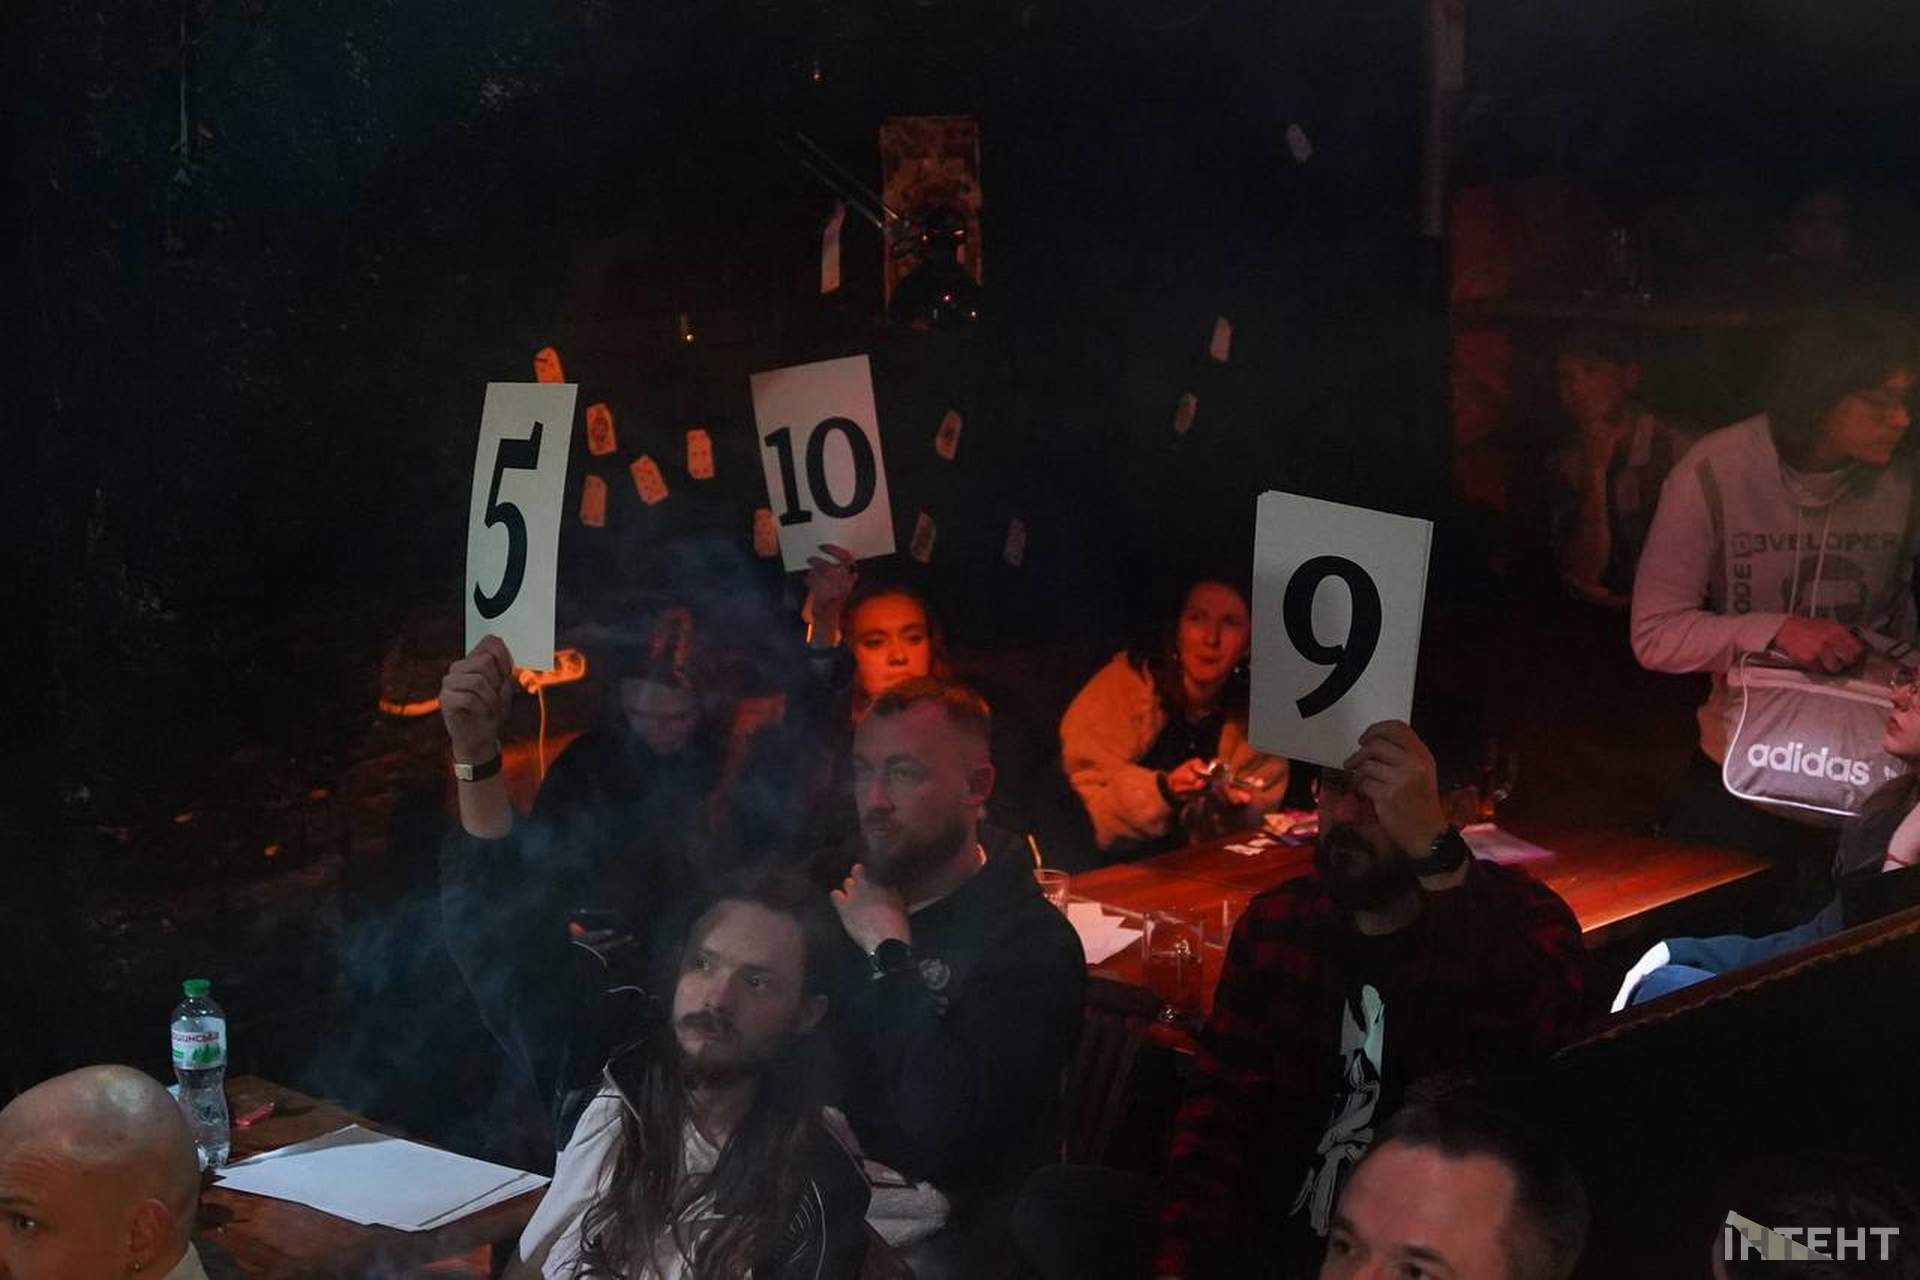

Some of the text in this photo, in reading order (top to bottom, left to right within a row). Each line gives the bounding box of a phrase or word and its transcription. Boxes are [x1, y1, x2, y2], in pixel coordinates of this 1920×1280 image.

[473, 421, 544, 619] 5
[764, 416, 877, 527] 10
[1283, 556, 1382, 718] 9
[1748, 742, 1870, 785] adidas
